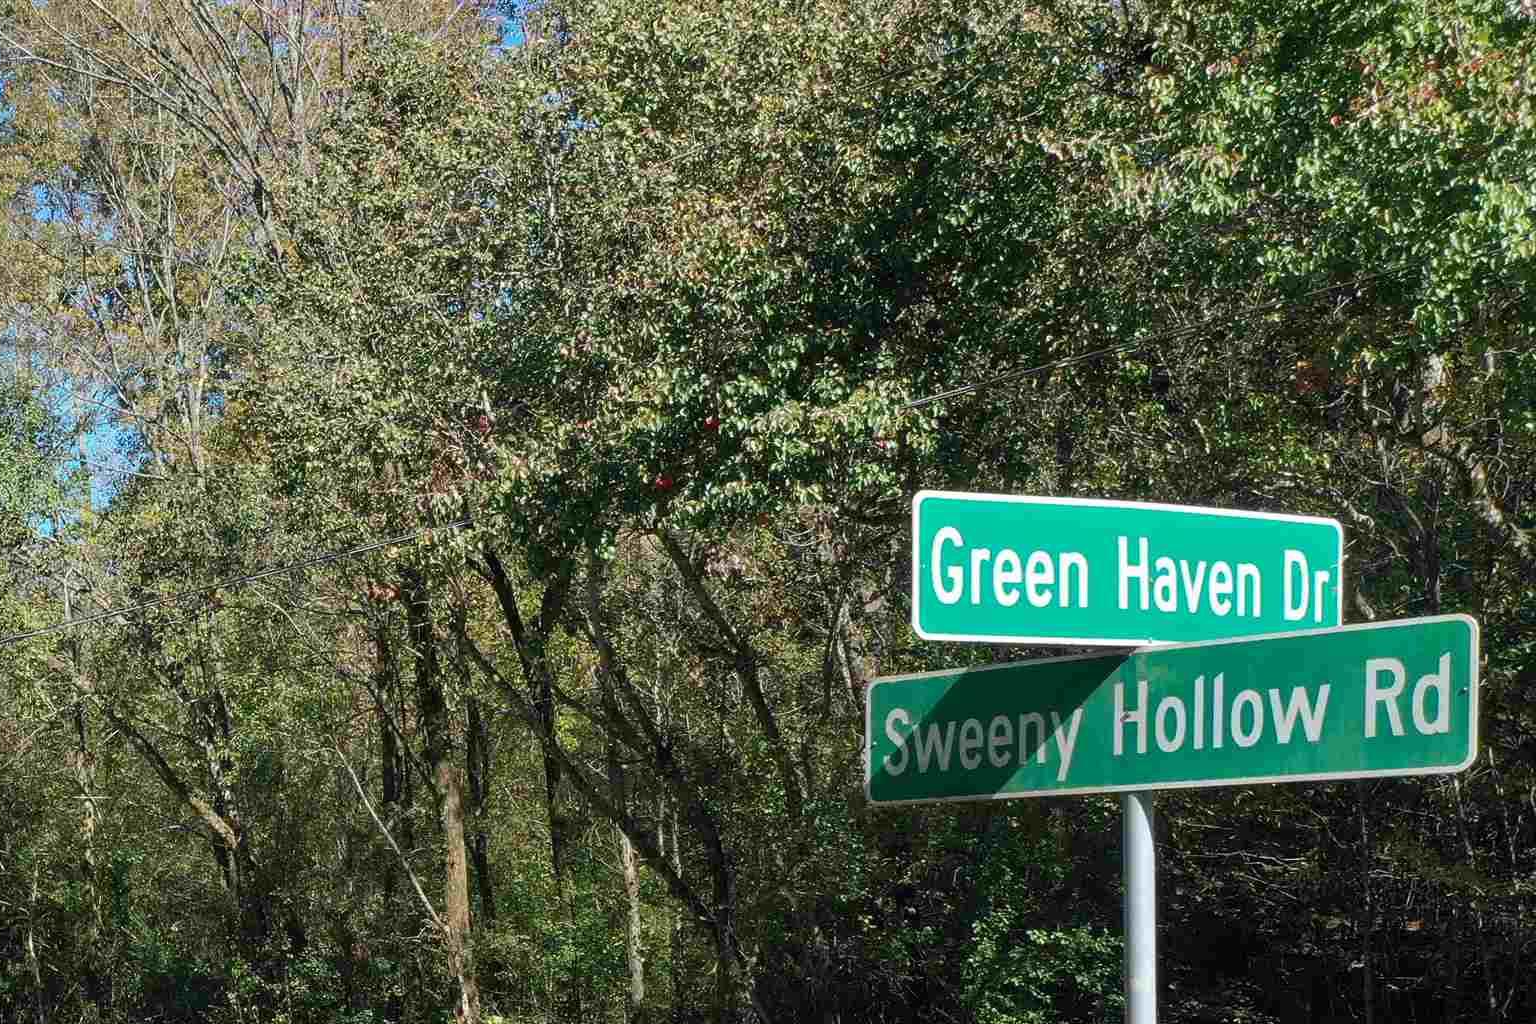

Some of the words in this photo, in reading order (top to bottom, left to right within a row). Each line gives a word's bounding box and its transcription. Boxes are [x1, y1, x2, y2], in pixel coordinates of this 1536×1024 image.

[930, 526, 1089, 608] Green
[1117, 535, 1261, 618] Haven
[1282, 549, 1330, 623] Dr
[882, 705, 1083, 782] Sweeny
[1112, 670, 1332, 757] Hollow
[1364, 652, 1454, 738] Rd
